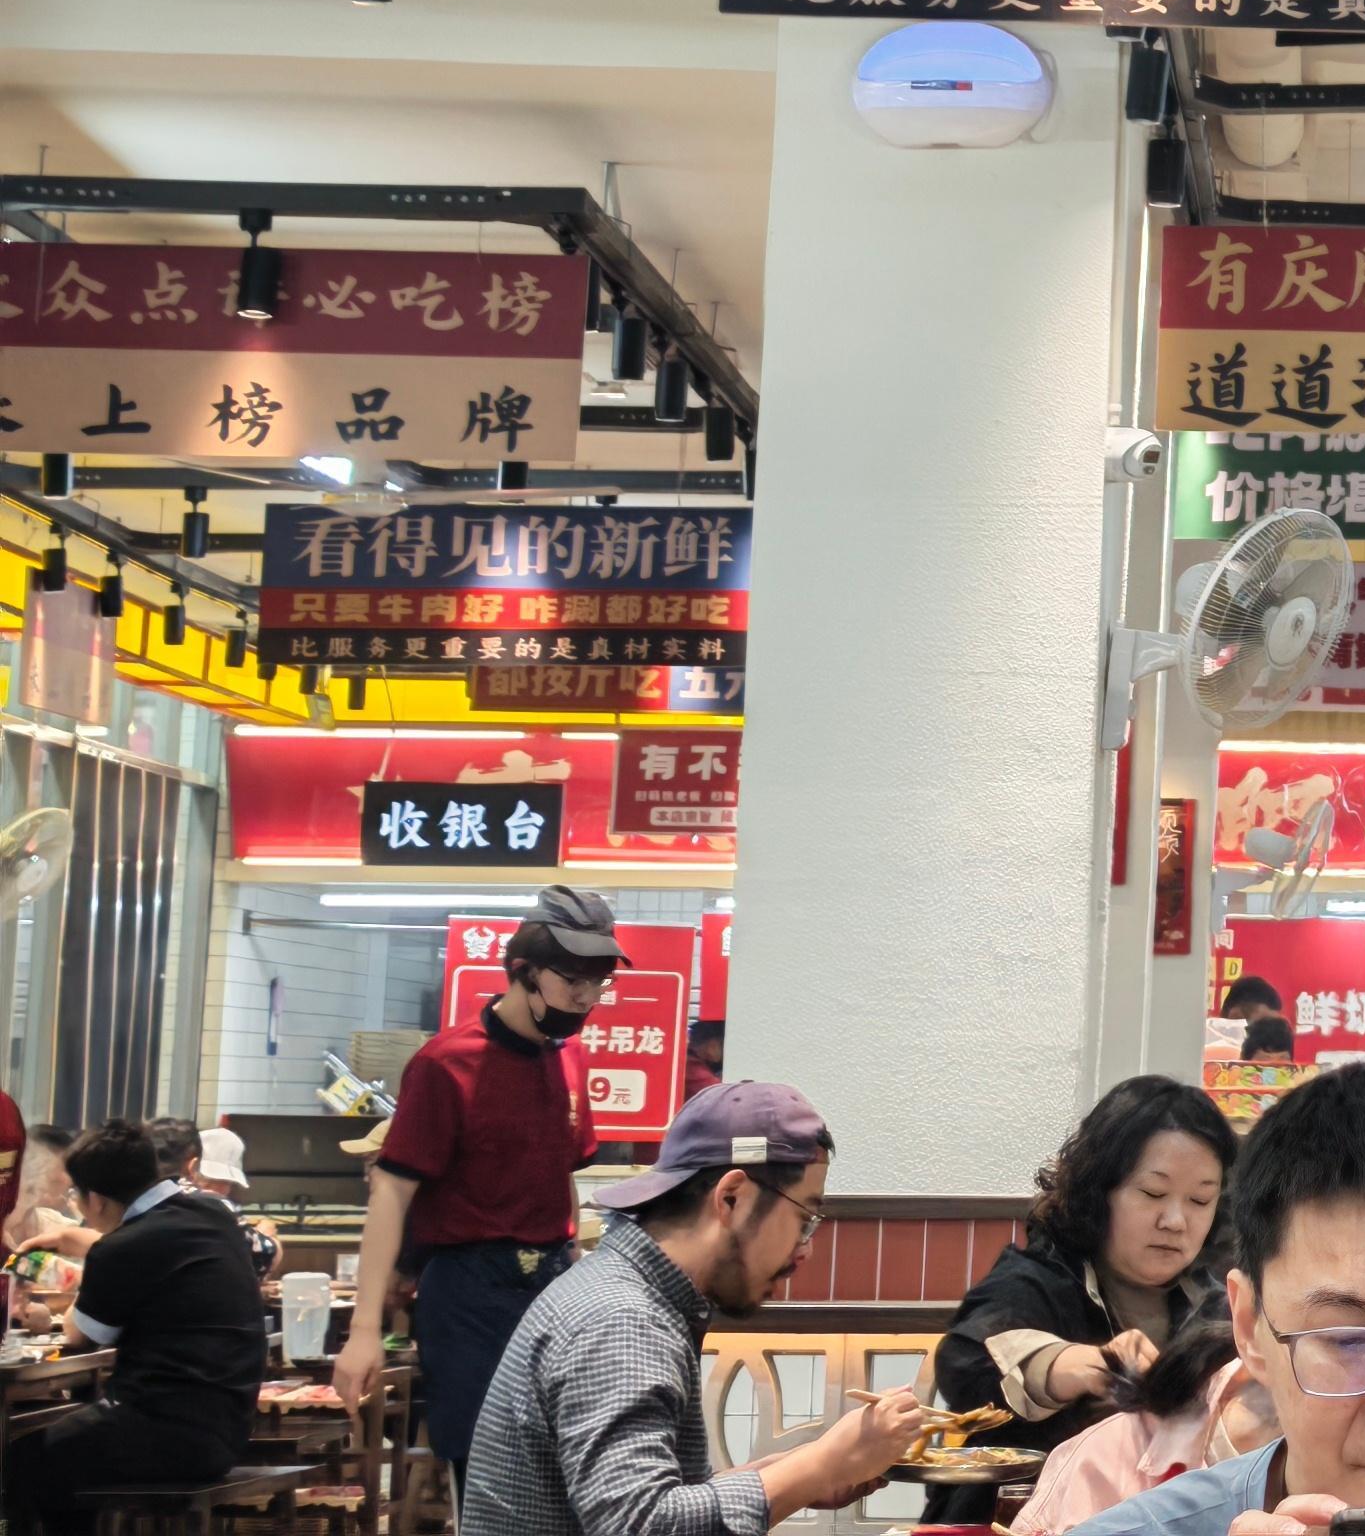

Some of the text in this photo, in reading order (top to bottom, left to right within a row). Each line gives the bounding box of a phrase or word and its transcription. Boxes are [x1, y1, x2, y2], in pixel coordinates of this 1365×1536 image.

[0, 259, 553, 336] 众点必吃榜
[292, 515, 735, 581] 看得见的新鲜
[289, 591, 731, 626] 只要牛肉好 咋涮都好吃
[291, 637, 727, 662] 比服务更重要的是真材实料
[379, 801, 547, 851] 收银台
